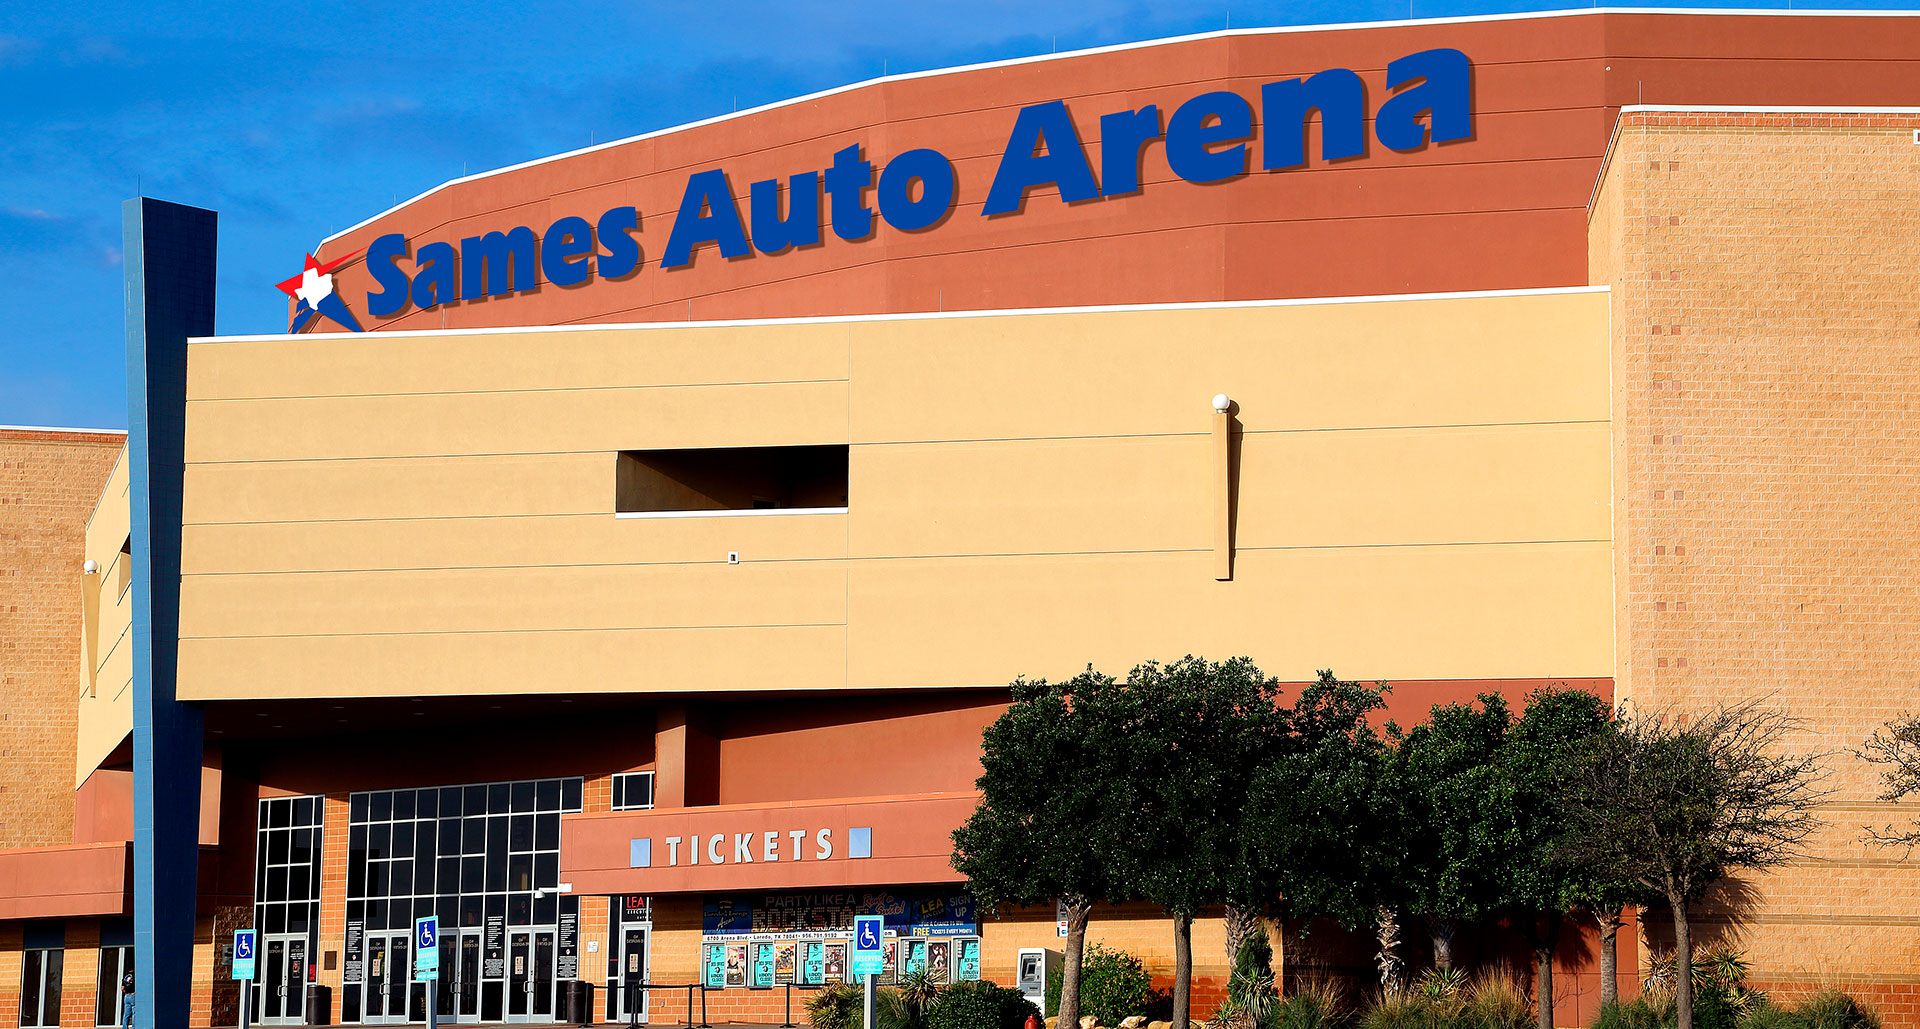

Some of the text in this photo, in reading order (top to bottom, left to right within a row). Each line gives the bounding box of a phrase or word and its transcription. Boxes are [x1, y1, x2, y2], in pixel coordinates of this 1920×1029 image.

[367, 48, 1471, 316] Sames Auto Arena
[665, 828, 833, 867] TICKETS
[626, 896, 645, 909] LEA
[765, 893, 856, 908] PARTY LIKE A
[921, 898, 944, 915] LEA
[949, 895, 971, 907] SIGN
[955, 906, 967, 918] UP
[913, 926, 930, 936] FREE
